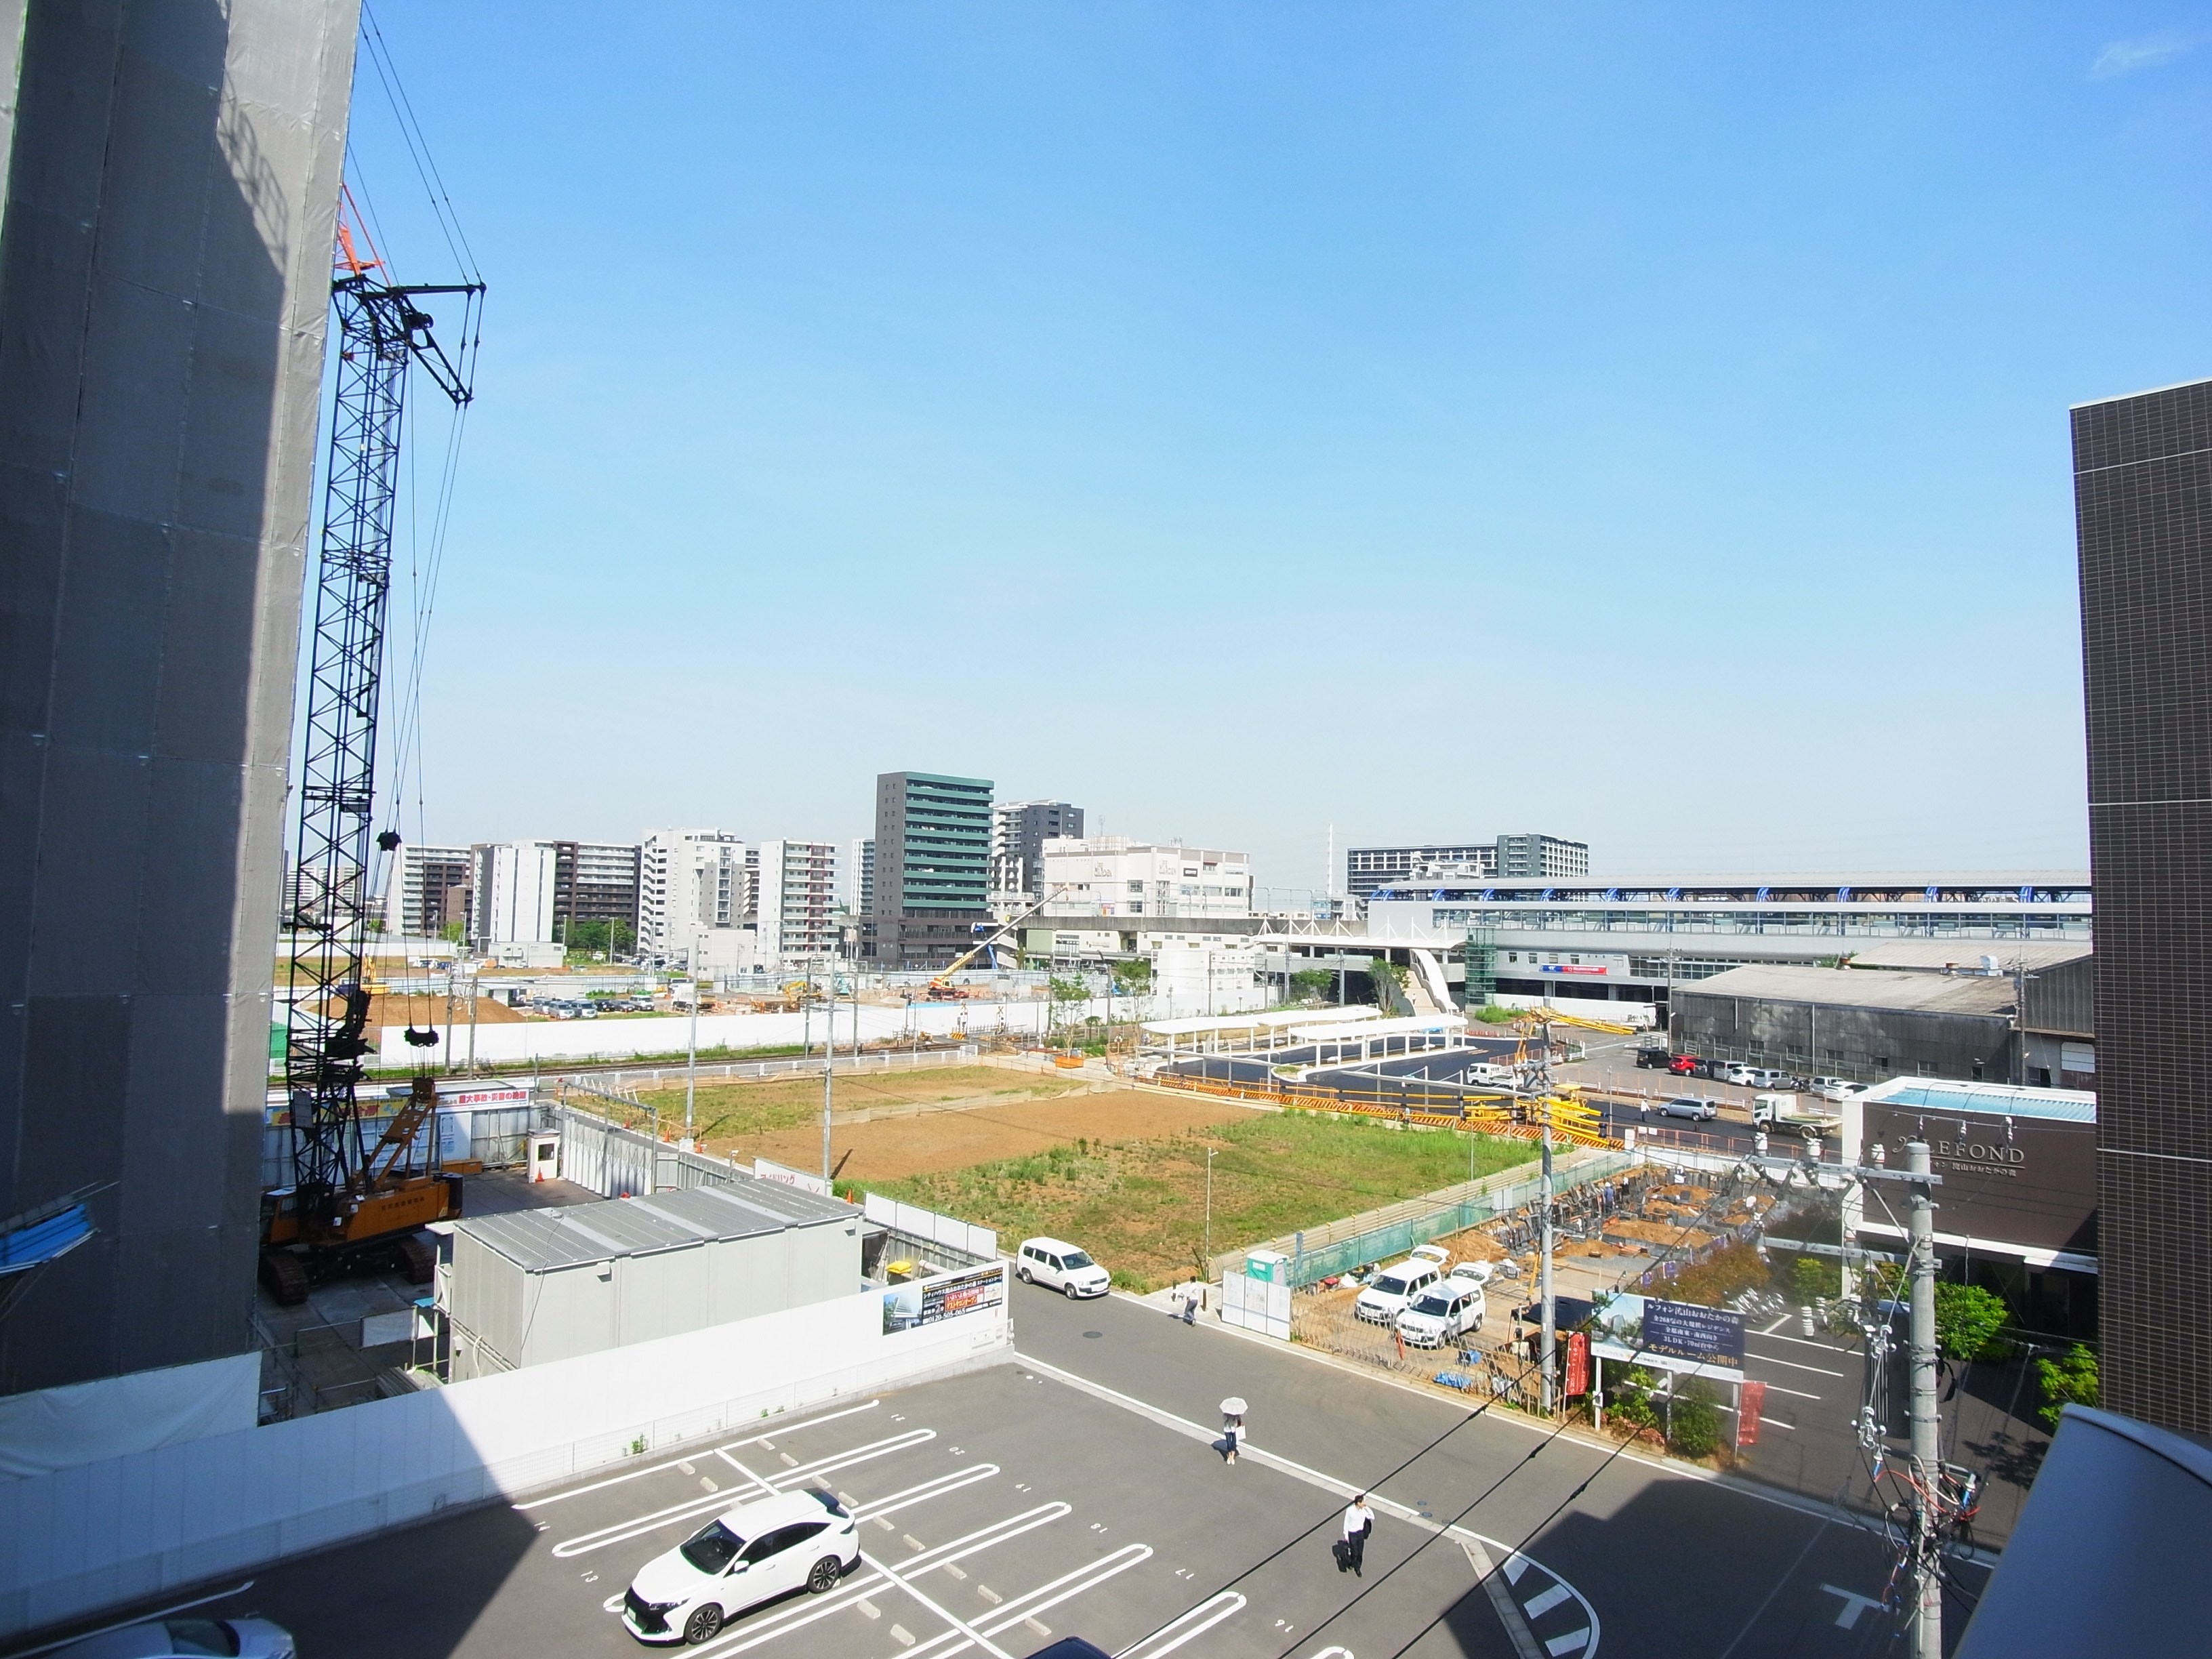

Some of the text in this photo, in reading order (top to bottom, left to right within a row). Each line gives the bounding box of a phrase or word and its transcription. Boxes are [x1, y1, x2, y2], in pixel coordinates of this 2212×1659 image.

[1648, 1343, 1739, 1368] モデルルーム公開中
